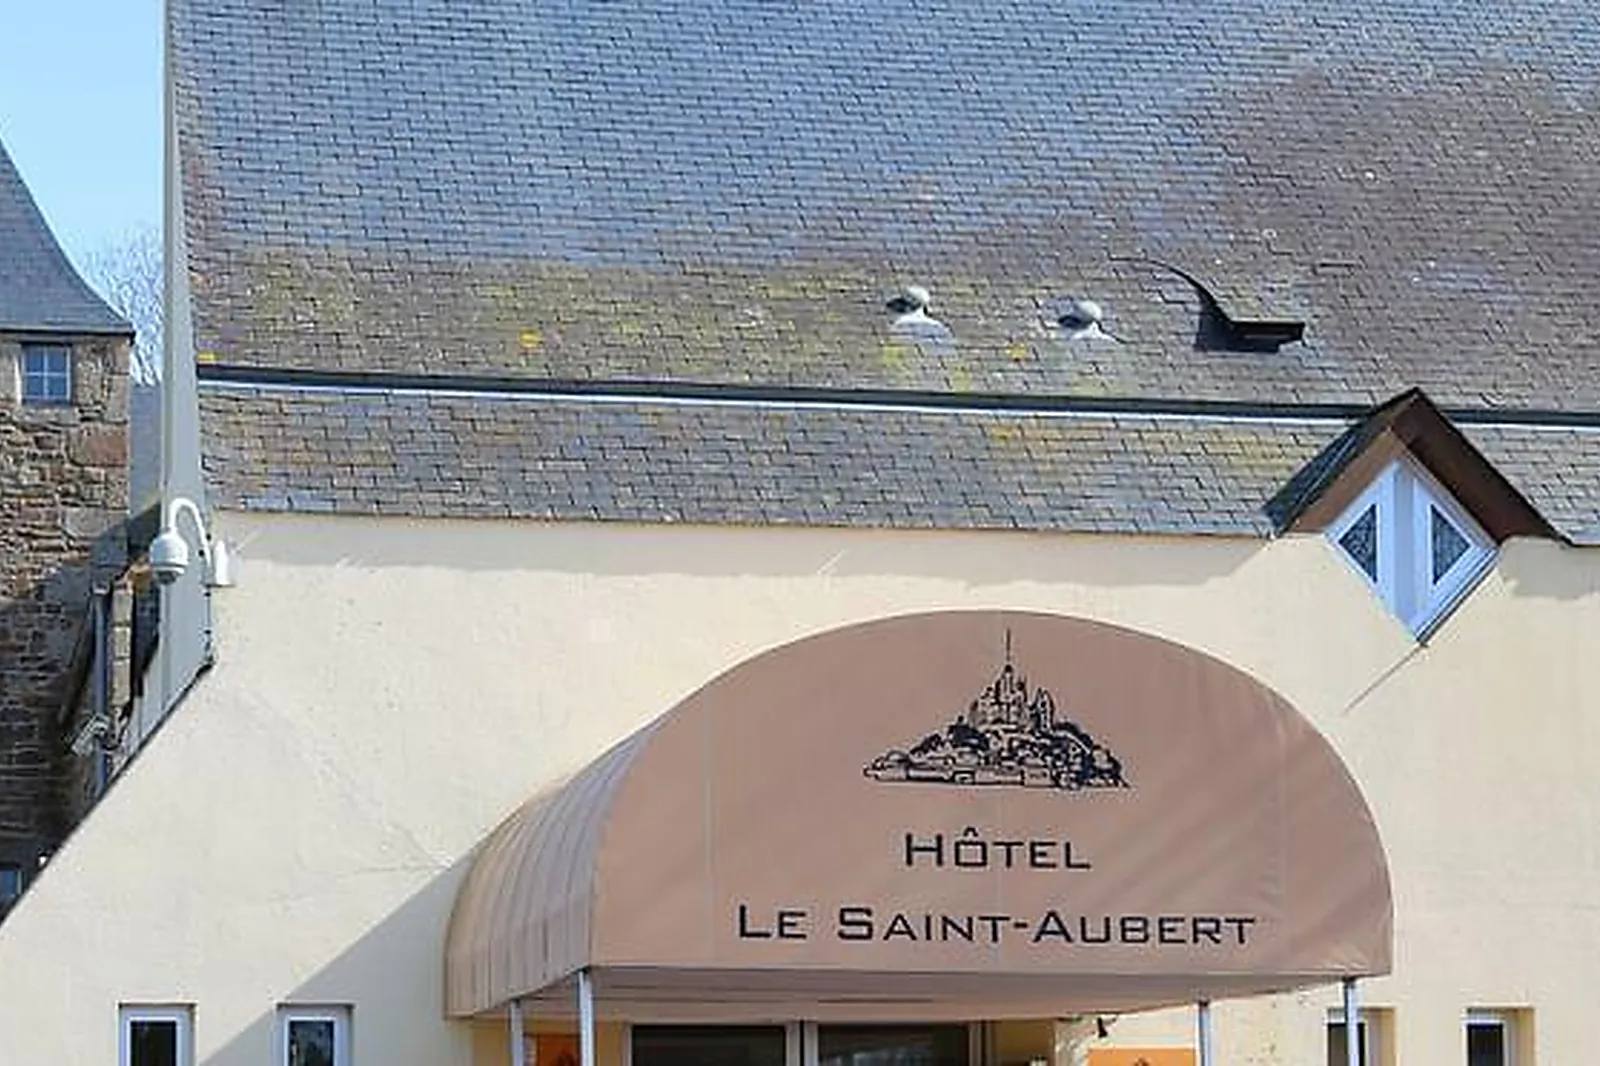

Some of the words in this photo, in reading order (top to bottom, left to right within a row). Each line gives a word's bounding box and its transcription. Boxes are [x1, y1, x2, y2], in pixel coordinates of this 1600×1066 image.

[904, 826, 1092, 870] HÔTEL
[738, 904, 809, 942] LE
[837, 907, 1256, 945] SAINT-AUBERT
